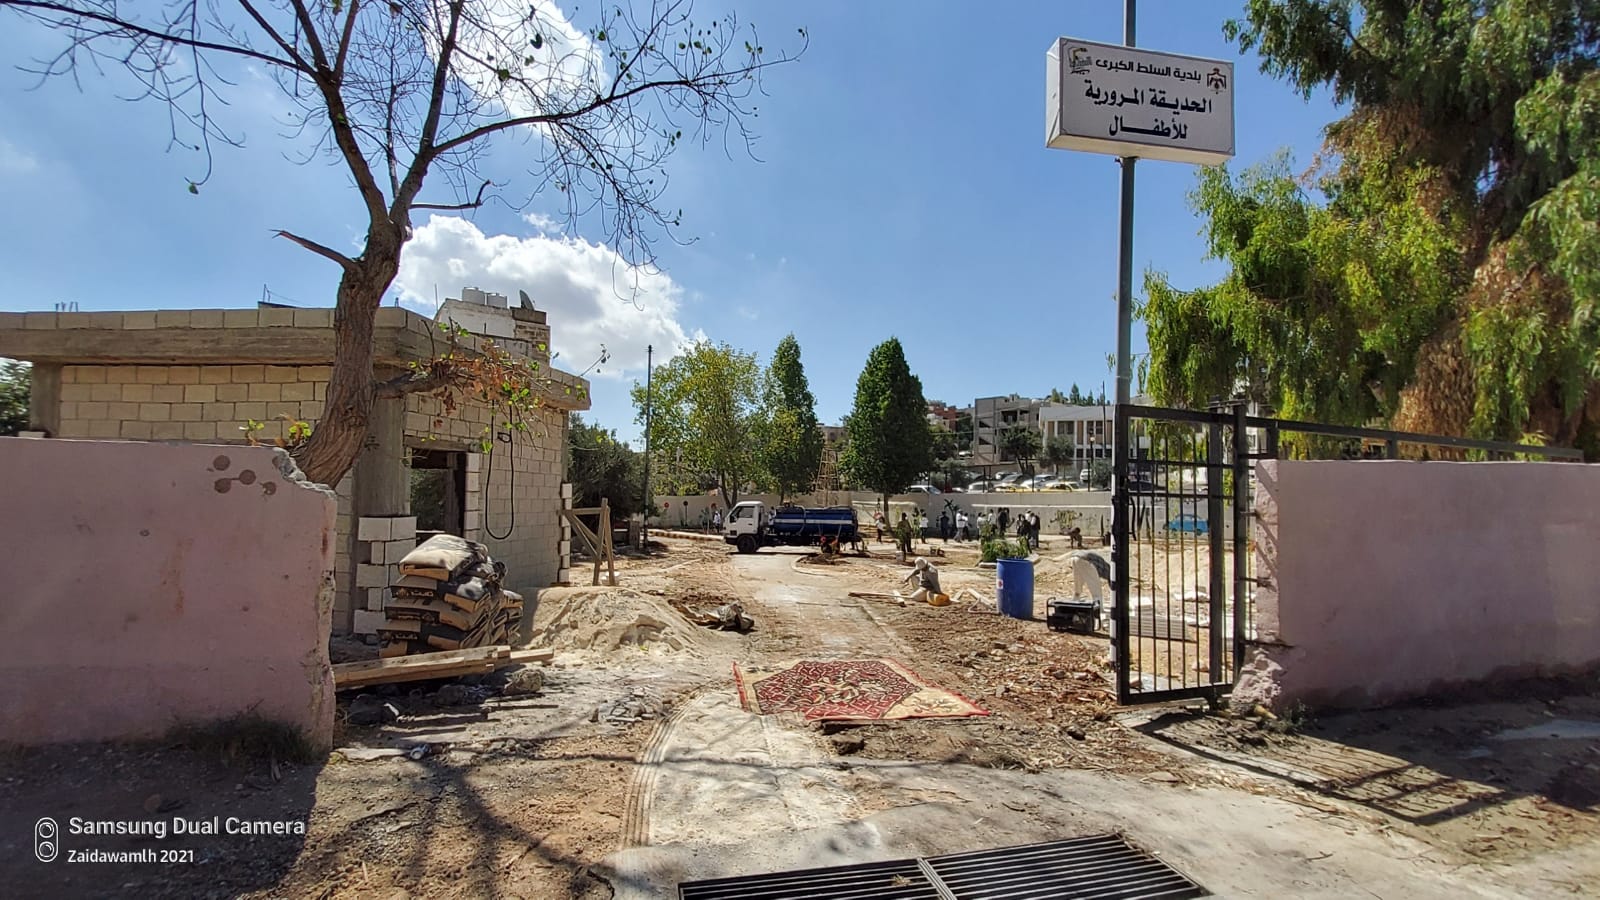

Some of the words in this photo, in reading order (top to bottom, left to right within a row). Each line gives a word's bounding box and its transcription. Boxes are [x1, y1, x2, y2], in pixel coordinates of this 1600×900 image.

[1095, 58, 1134, 73] الكبرى
[1136, 62, 1171, 77] السلط
[1173, 67, 1202, 82] بلدية
[1084, 79, 1144, 107] المرورية
[1148, 88, 1212, 115] الحديقة
